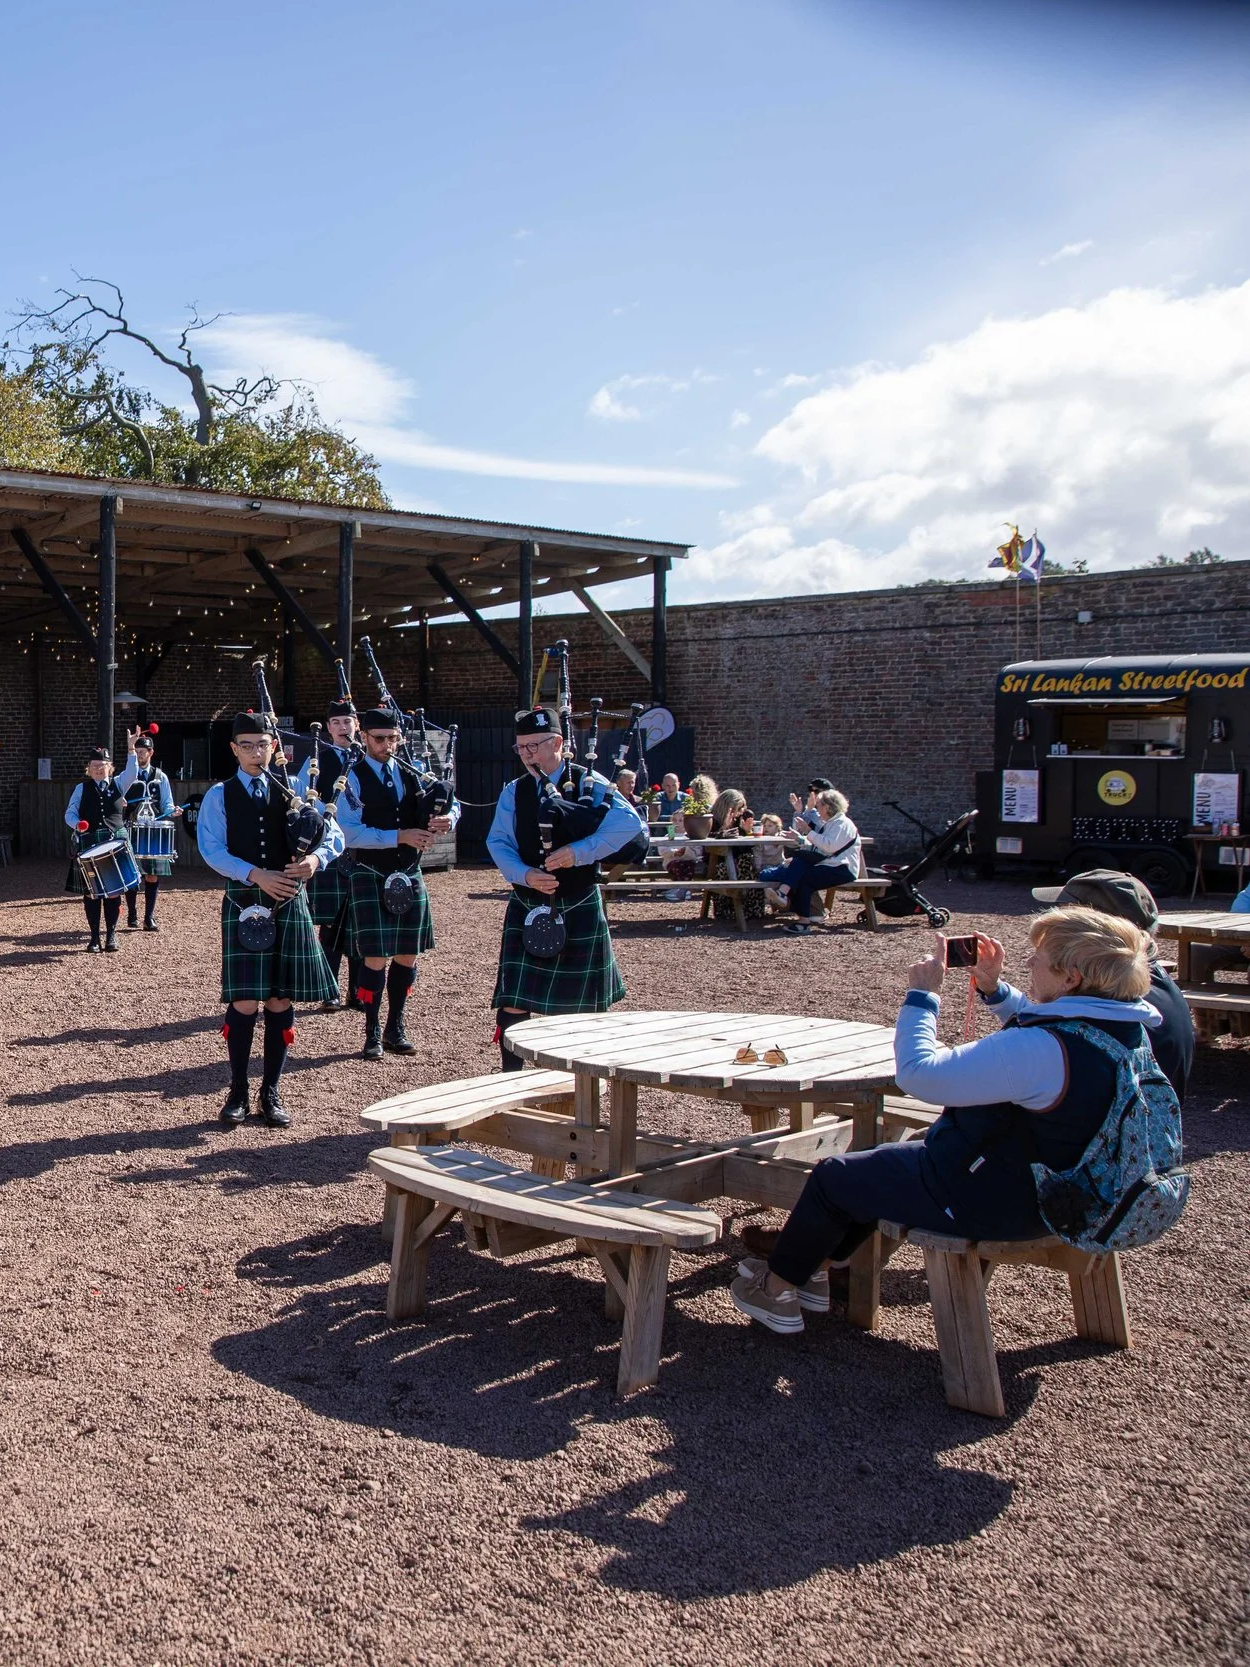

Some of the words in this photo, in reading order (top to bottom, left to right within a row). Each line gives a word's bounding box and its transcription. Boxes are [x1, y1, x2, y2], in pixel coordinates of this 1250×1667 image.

[1000, 673, 1031, 693] Sri
[1031, 672, 1113, 695] Lankan
[1118, 667, 1250, 692] Streetfood
[1004, 786, 1017, 817] MENU
[1196, 792, 1213, 825] MENU
